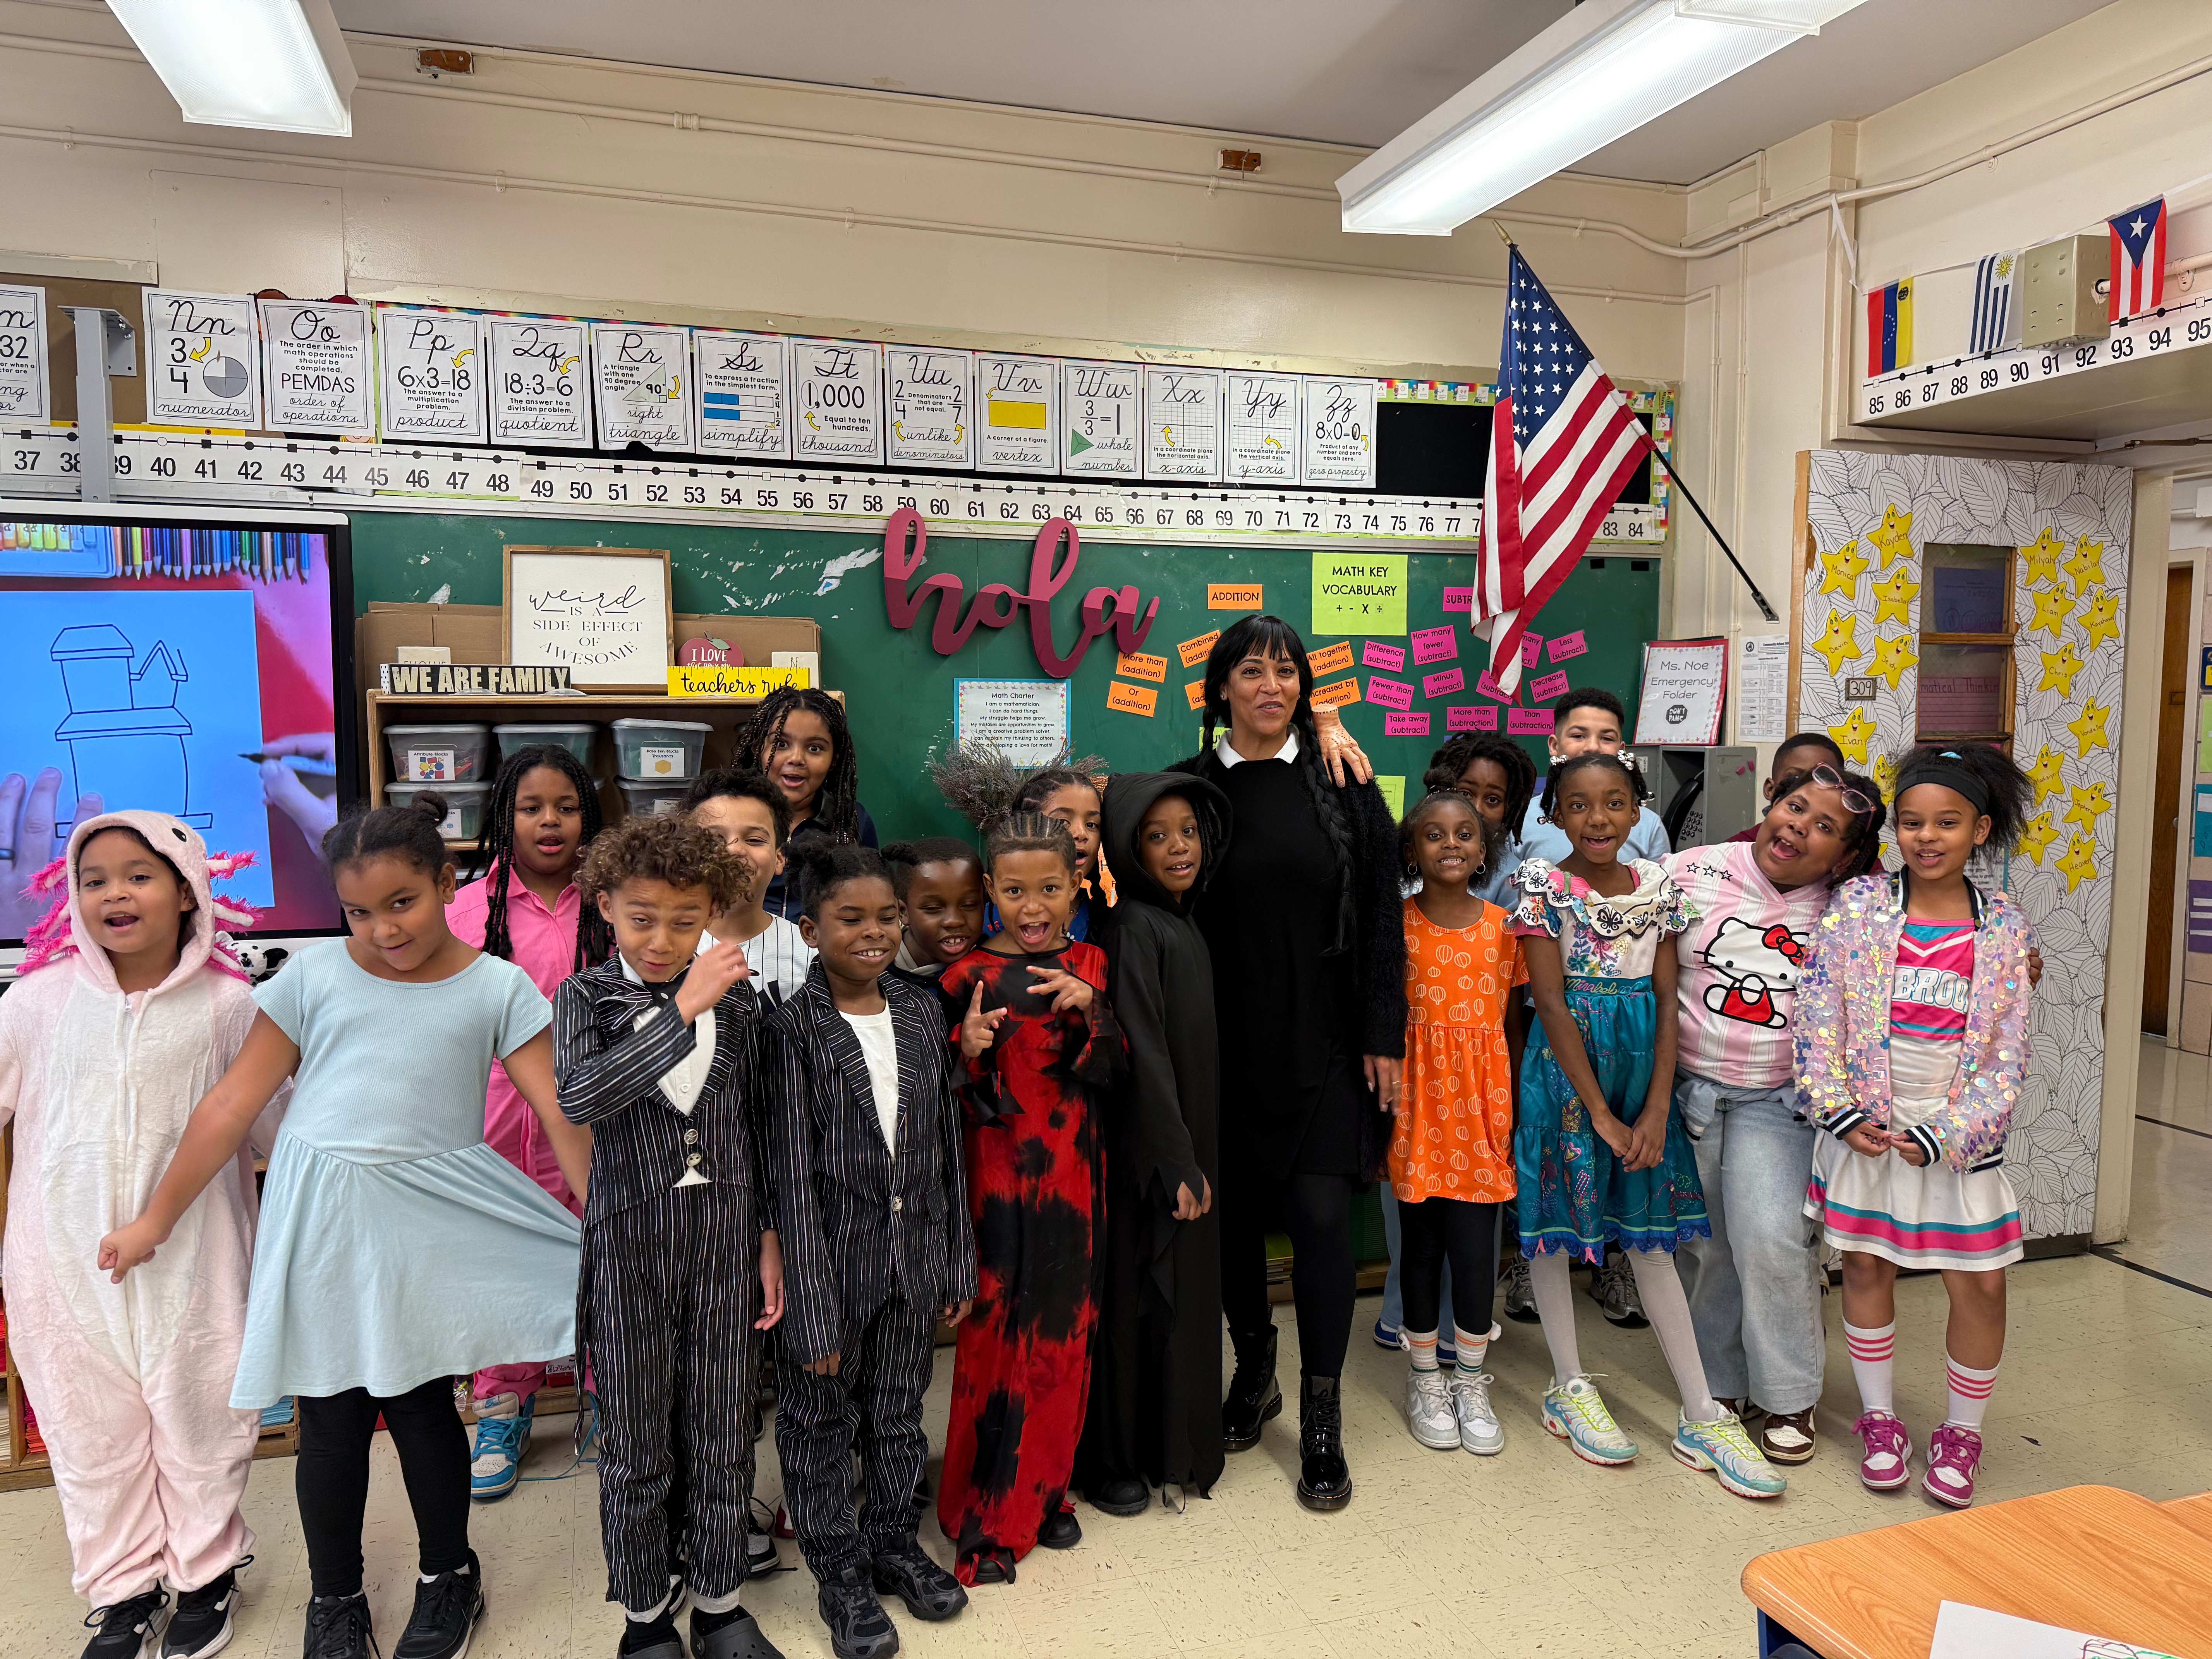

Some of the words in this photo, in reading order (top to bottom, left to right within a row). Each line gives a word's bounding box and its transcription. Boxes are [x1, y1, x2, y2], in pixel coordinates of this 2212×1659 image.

[1869, 395, 1884, 414] 85
[1895, 389, 1911, 408] 86
[1922, 383, 1939, 402] 87
[1951, 376, 1968, 395] 88
[1980, 369, 1998, 389] 89
[2010, 361, 2029, 382] 90
[2041, 353, 2060, 375] 91
[2075, 345, 2097, 368] 92
[2111, 337, 2133, 359] 93
[2149, 327, 2171, 350] 94
[2188, 318, 2211, 342] 95
[282, 373, 355, 393] PEMDAS
[290, 394, 327, 406] order
[331, 395, 344, 410] of
[407, 396, 459, 404] multiplication
[809, 383, 864, 408] 1,000
[158, 404, 251, 417] numerator
[283, 409, 359, 424] operations
[627, 407, 663, 423] right
[396, 412, 467, 429] product
[500, 416, 578, 436] quotient
[824, 415, 846, 423] Equal
[609, 424, 680, 446] triangle
[833, 424, 871, 432] hundreds.
[907, 428, 951, 442] unlike
[703, 428, 781, 450] simplify
[802, 436, 874, 453] thousand
[1096, 438, 1133, 450] whole
[894, 447, 964, 459] denominators
[993, 448, 1042, 462] vertex
[1082, 459, 1133, 471] number
[1159, 462, 1206, 474] x-axis
[1239, 463, 1285, 478] y-axis
[1309, 467, 1327, 477] zero
[1327, 469, 1367, 480] property
[150, 458, 176, 477] 40
[194, 459, 218, 479] 41
[237, 461, 262, 480] 42
[280, 463, 305, 482] 43
[323, 465, 347, 484] 44
[365, 468, 388, 485] 45
[406, 469, 429, 488] 46
[447, 472, 469, 489] 47
[486, 474, 509, 492] 48
[531, 480, 553, 497] 49
[570, 482, 592, 499] 50
[608, 484, 628, 501] 51
[646, 485, 668, 502] 52
[684, 487, 705, 503] 53
[721, 488, 742, 505] 54
[757, 490, 778, 507] 55
[793, 492, 814, 508] 56
[829, 493, 848, 510] 57
[1878, 531, 1908, 548] Kayden
[2029, 555, 2054, 567] Milyah
[1333, 566, 1364, 577] MATH
[1370, 567, 1388, 577] KEY
[1831, 564, 1854, 581] Monica
[2075, 562, 2097, 575] Nabila
[884, 508, 1159, 678] hola
[1212, 592, 1259, 601] ADDITION
[1322, 585, 1397, 596] VOCABULARY
[529, 585, 646, 611] weird
[1883, 596, 1906, 604] Isabella
[570, 607, 582, 616] IS
[592, 607, 602, 616] A
[2042, 604, 2058, 616] Liam
[533, 620, 570, 630] SIDE
[582, 622, 642, 632] EFFECT
[1431, 628, 1451, 637] many
[579, 637, 599, 646] OF
[1181, 632, 1219, 652] Combined
[1423, 641, 1443, 649] fewer
[1829, 642, 1848, 654] Devin
[539, 641, 637, 665] AWESOME
[692, 649, 696, 661] I
[701, 647, 727, 662] LOVE
[1319, 644, 1350, 659] together
[1367, 644, 1403, 657] Difference
[1418, 649, 1452, 662] (subtract)
[1553, 645, 1584, 660] (subtract)
[1123, 653, 1144, 663] More
[1147, 658, 1163, 666] than
[1314, 655, 1348, 672] (addition)
[1366, 654, 1400, 668] (subtract)
[1660, 661, 1680, 670] Ms.
[1684, 661, 1709, 670] Noe
[1881, 655, 1897, 672] Jeidy
[1123, 665, 1161, 678] (addition)
[1433, 672, 1453, 683] Minus
[2049, 667, 2067, 677] Chris
[392, 667, 432, 692] WE
[438, 667, 483, 692] ARE
[489, 667, 568, 693] FAMILY
[680, 672, 756, 694] teachers
[1532, 673, 1563, 687] Decrease
[1651, 678, 1714, 687] Emergency
[1372, 680, 1393, 691] Fewer
[1396, 685, 1412, 695] than
[1429, 680, 1462, 696] (subtract)
[1534, 683, 1566, 698] (subtract)
[1663, 690, 1697, 699] Folder
[1850, 680, 1872, 696] 309
[1112, 696, 1150, 711] (addition)
[1373, 691, 1407, 706] (subtract)
[1840, 735, 1863, 745] Ivan
[2069, 857, 2092, 872] Heaven
